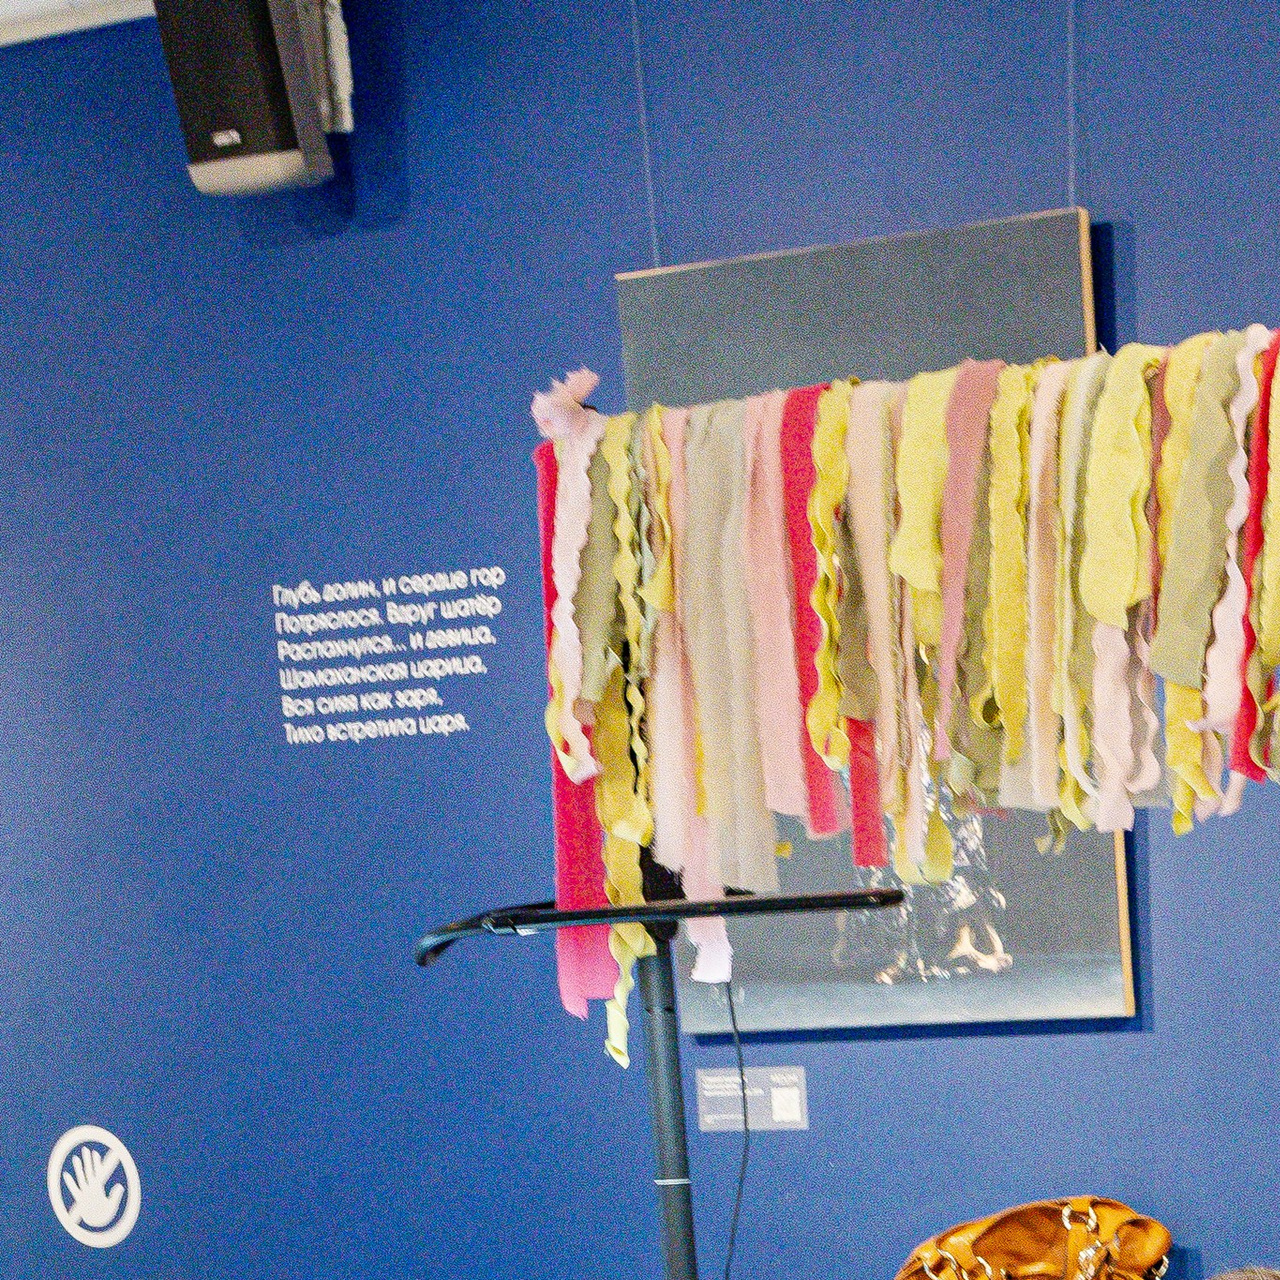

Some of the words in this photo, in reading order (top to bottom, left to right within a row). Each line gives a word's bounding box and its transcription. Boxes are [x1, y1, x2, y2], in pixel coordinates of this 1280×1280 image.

[272, 580, 322, 609] Глубь
[470, 565, 506, 589] гор
[386, 601, 438, 626] Вдруг
[279, 661, 409, 690] Шамаханская
[281, 695, 317, 717] Вся
[360, 692, 393, 711] как
[283, 723, 325, 744] Тихо
[326, 717, 417, 743] встретила
